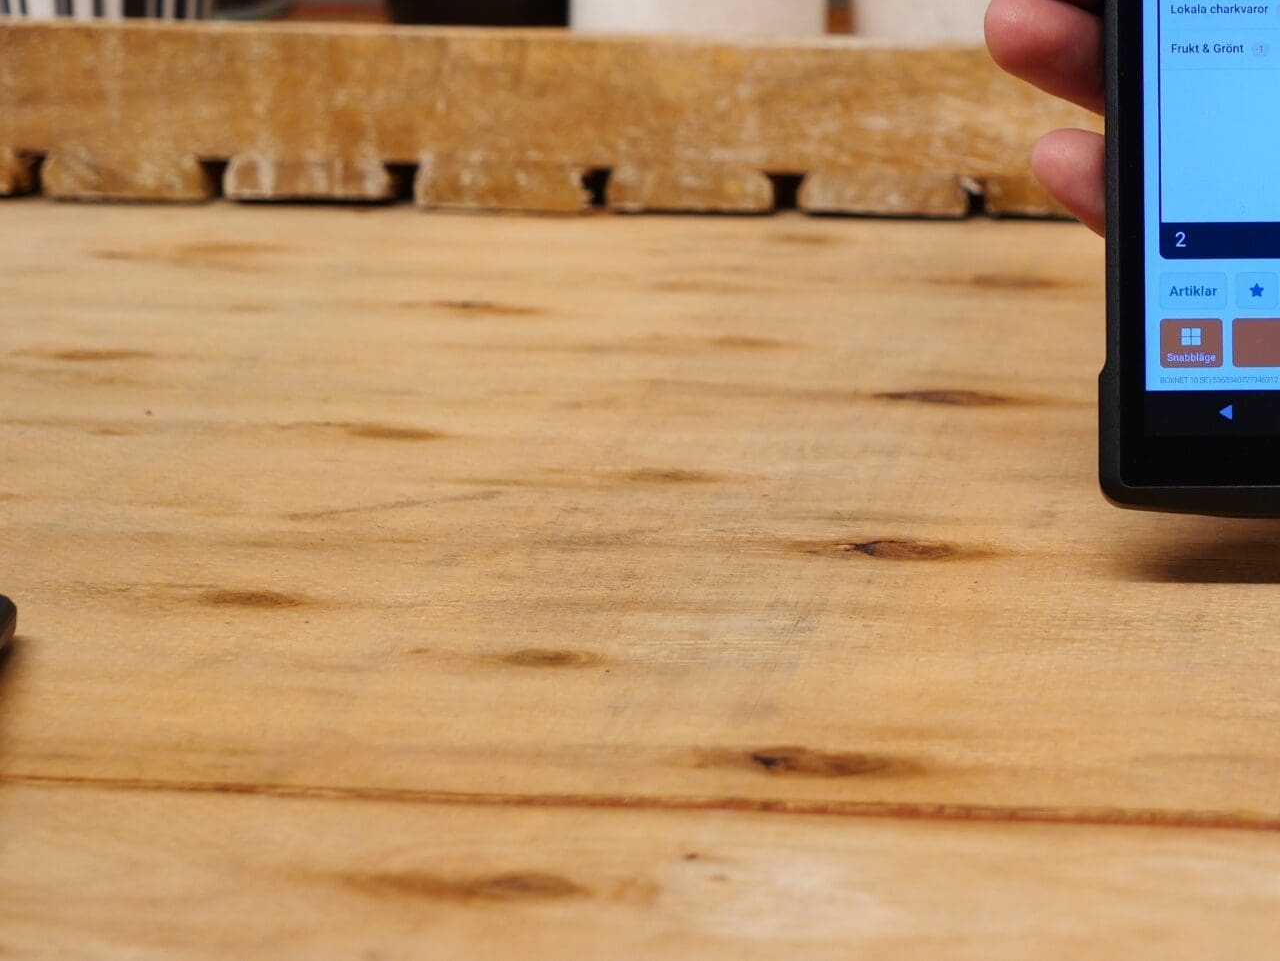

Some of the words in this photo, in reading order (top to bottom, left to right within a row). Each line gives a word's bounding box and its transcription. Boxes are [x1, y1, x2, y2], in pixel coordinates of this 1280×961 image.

[1170, 3, 1207, 14] Lokala
[1210, 3, 1269, 14] charkvaror
[1171, 43, 1199, 54] Frukt
[1202, 43, 1210, 54] &
[1213, 43, 1244, 54] Grönt
[1175, 231, 1187, 248] 2
[1168, 285, 1218, 297] Artiklar
